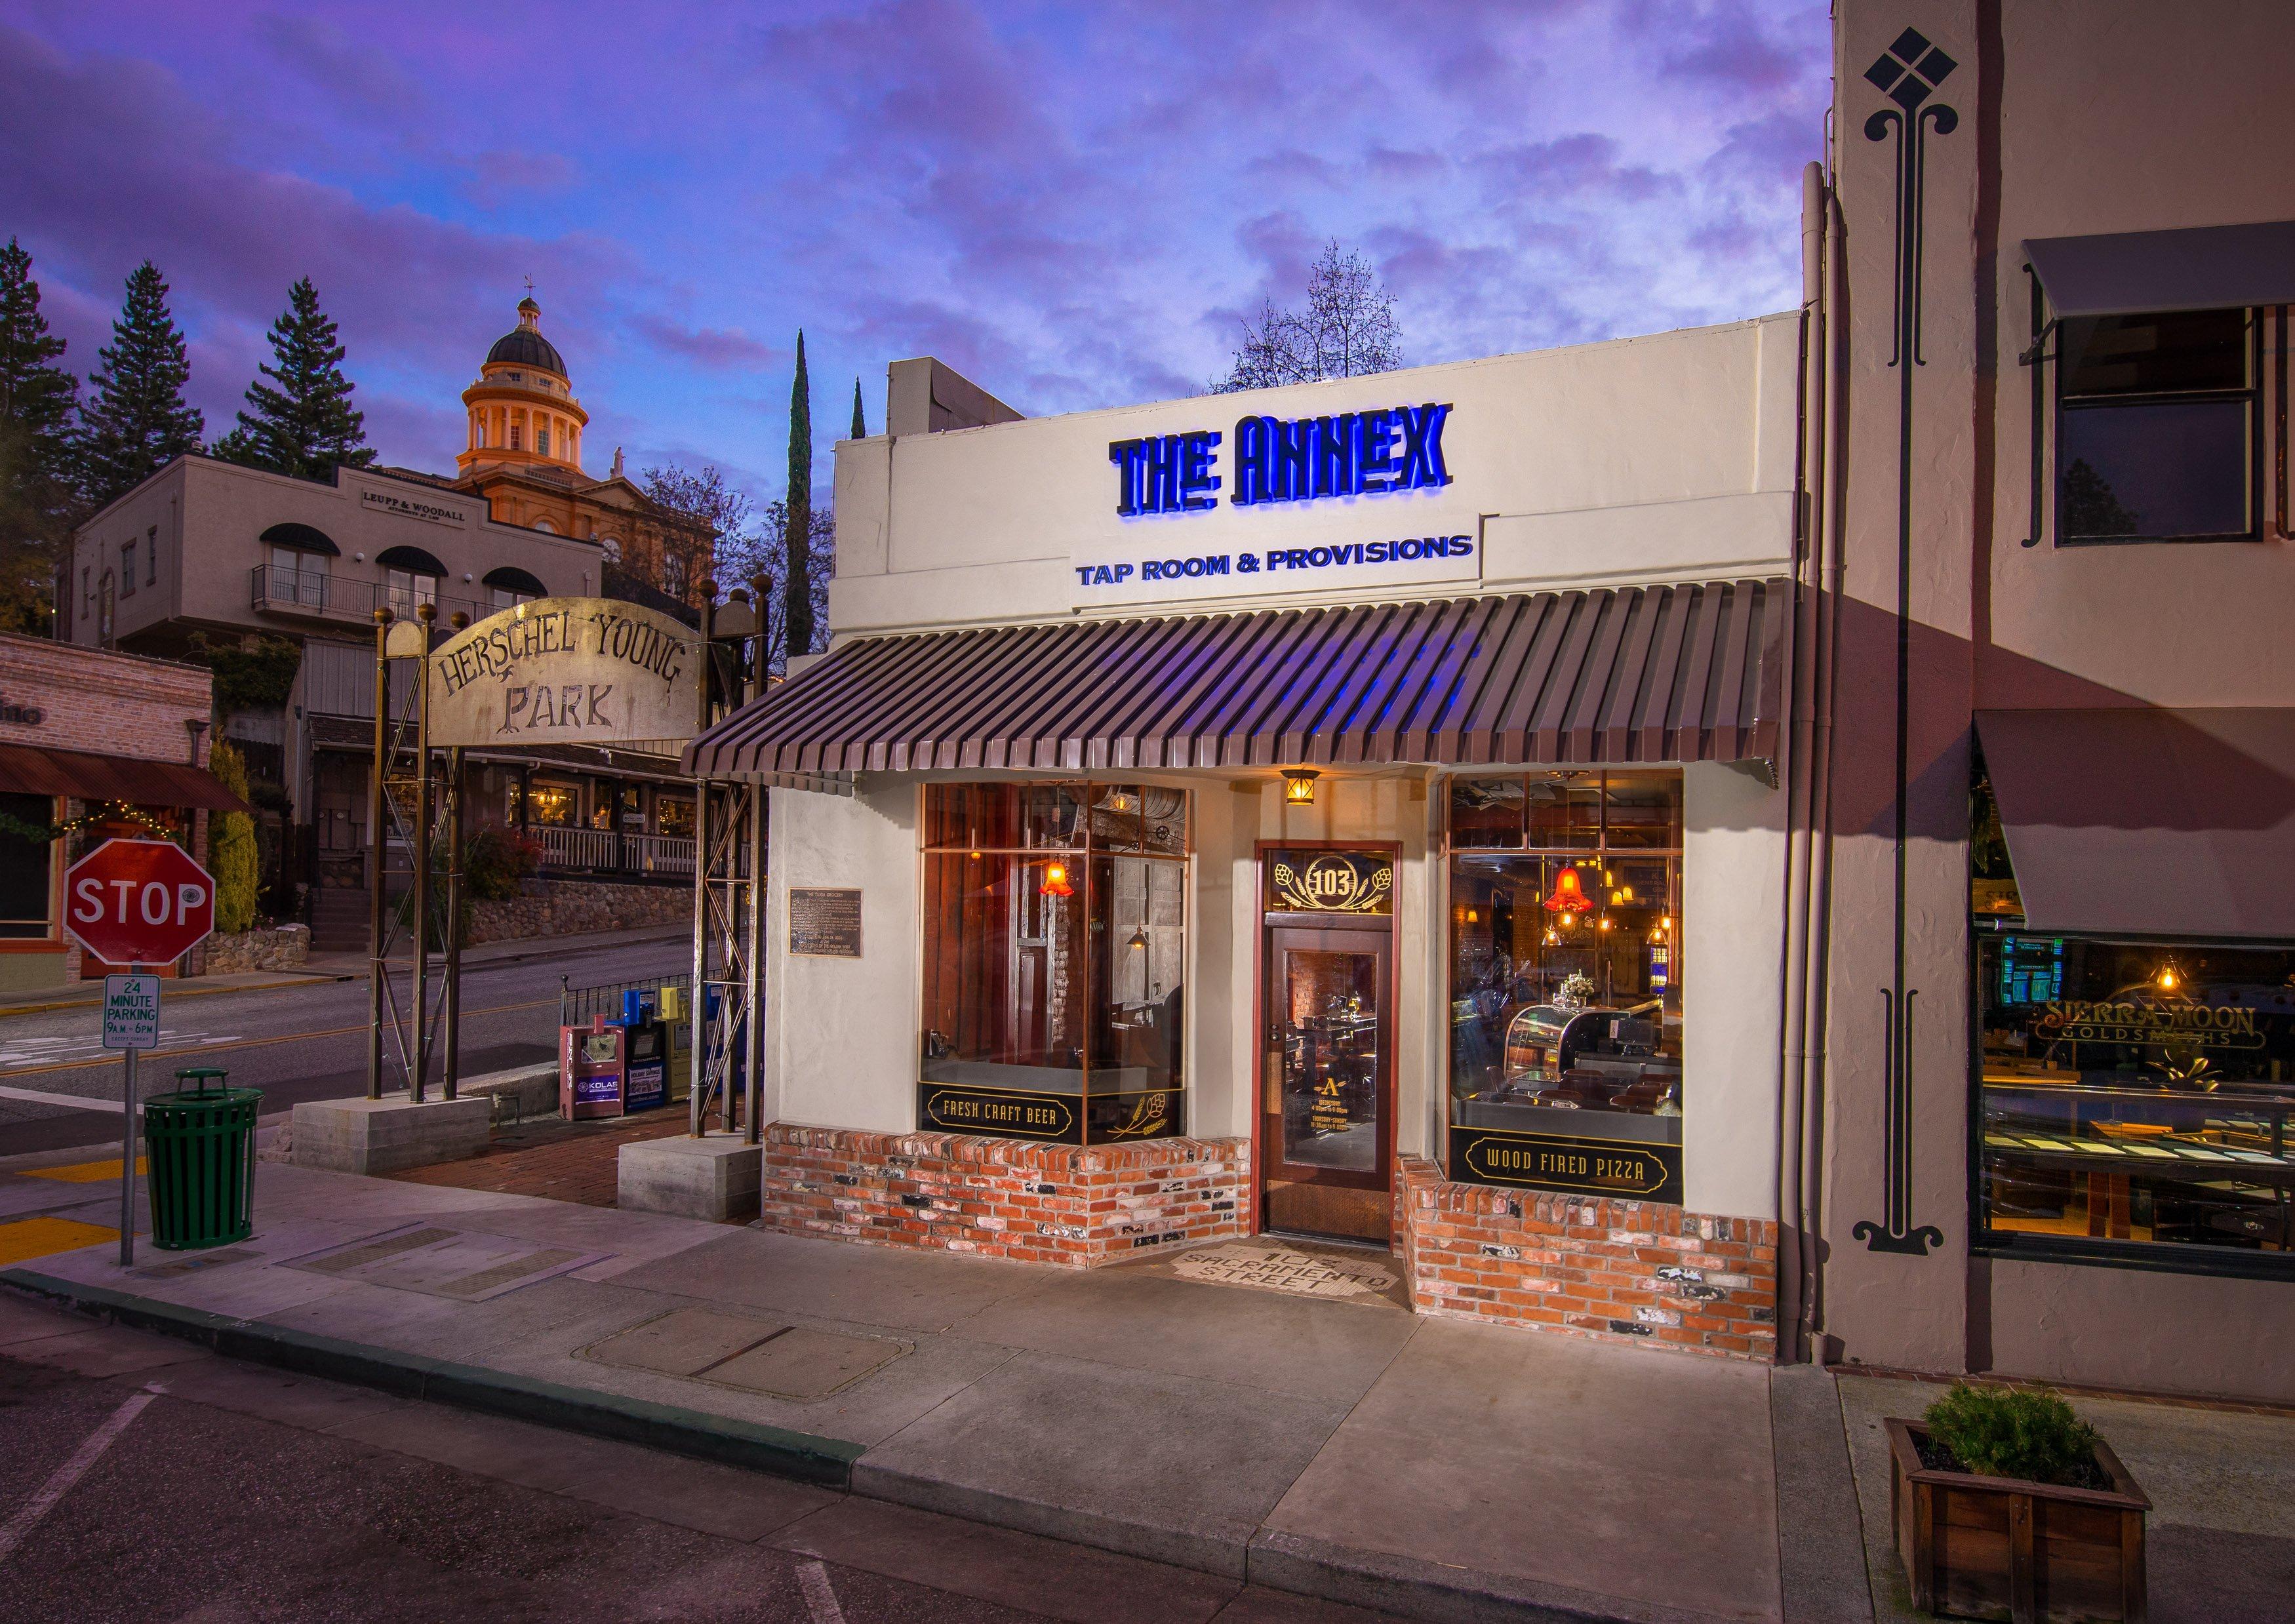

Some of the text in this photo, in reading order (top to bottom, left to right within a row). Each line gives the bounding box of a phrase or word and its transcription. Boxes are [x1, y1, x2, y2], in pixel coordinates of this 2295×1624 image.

[1109, 403, 1454, 517] THE ANNEX
[363, 492, 465, 521] LEUPP & WOODALL
[388, 506, 418, 516] ATTORNEYS
[1075, 534, 1474, 585] TAP ROOM & PROVISIONS
[439, 611, 687, 698] HERSCHEL YOUNG
[496, 684, 612, 734] PARK
[1312, 869, 1349, 896] 103
[73, 878, 207, 926] STOP
[111, 995, 153, 1007] MINUTE
[125, 982, 141, 994] 24
[108, 1008, 155, 1021] PARKING
[2044, 1000, 2258, 1037] SIERRA MOON
[2062, 1026, 2230, 1045] GOLDSMITHS
[1321, 1077, 1339, 1096] A
[944, 1099, 1056, 1126] FRESH CRAFT BEER
[1487, 1148, 1645, 1180] WOOD FIRED PIZZA
[1183, 1254, 1389, 1286] SACRAMENTO
[1263, 1253, 1341, 1269] 103
[1197, 1267, 1330, 1289] STREET
